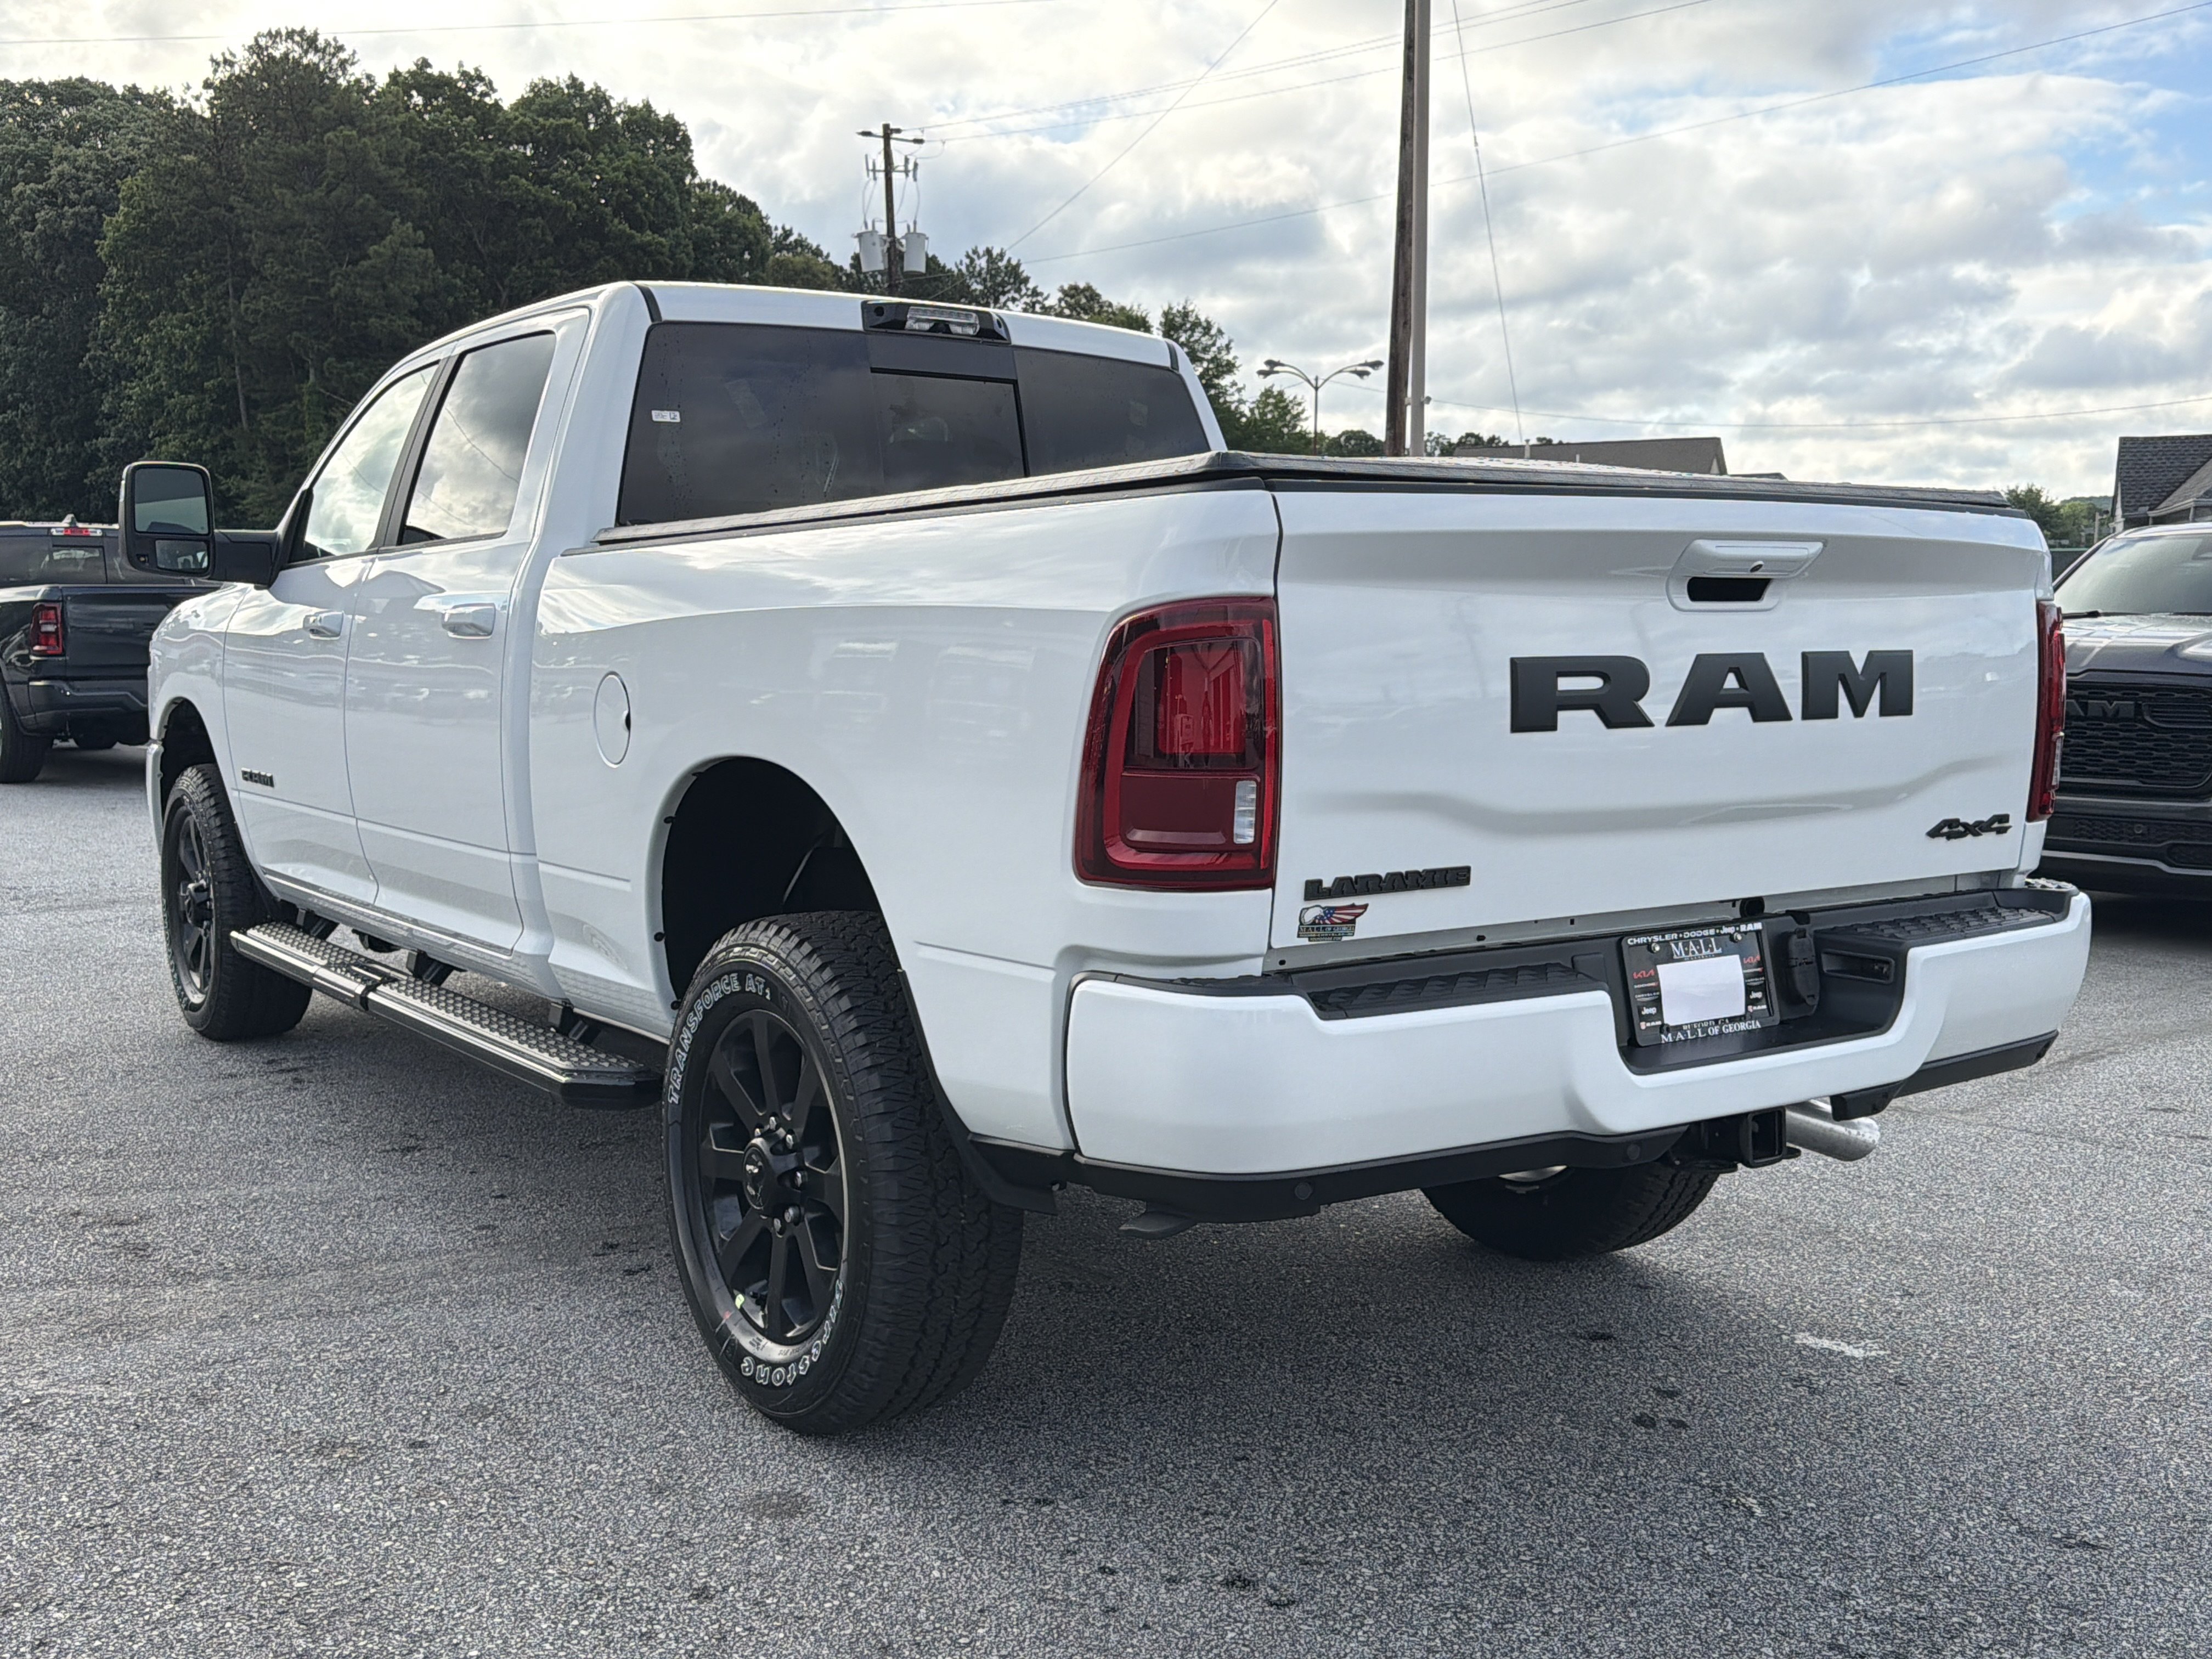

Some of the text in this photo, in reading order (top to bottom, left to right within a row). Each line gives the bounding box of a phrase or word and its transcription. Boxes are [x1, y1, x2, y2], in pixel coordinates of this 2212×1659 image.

[1510, 650, 1914, 733] RAM
[1926, 814, 2012, 841] 4x4
[1304, 865, 1471, 901] LARAMIE
[1627, 933, 1678, 945] CHRYSLER
[1683, 928, 1715, 938] DODGE
[1740, 922, 1763, 932] RAM
[668, 973, 741, 1104] TRANSFORCE
[1708, 1025, 1720, 1036] OF
[1722, 1020, 1762, 1034] GEORGIA
